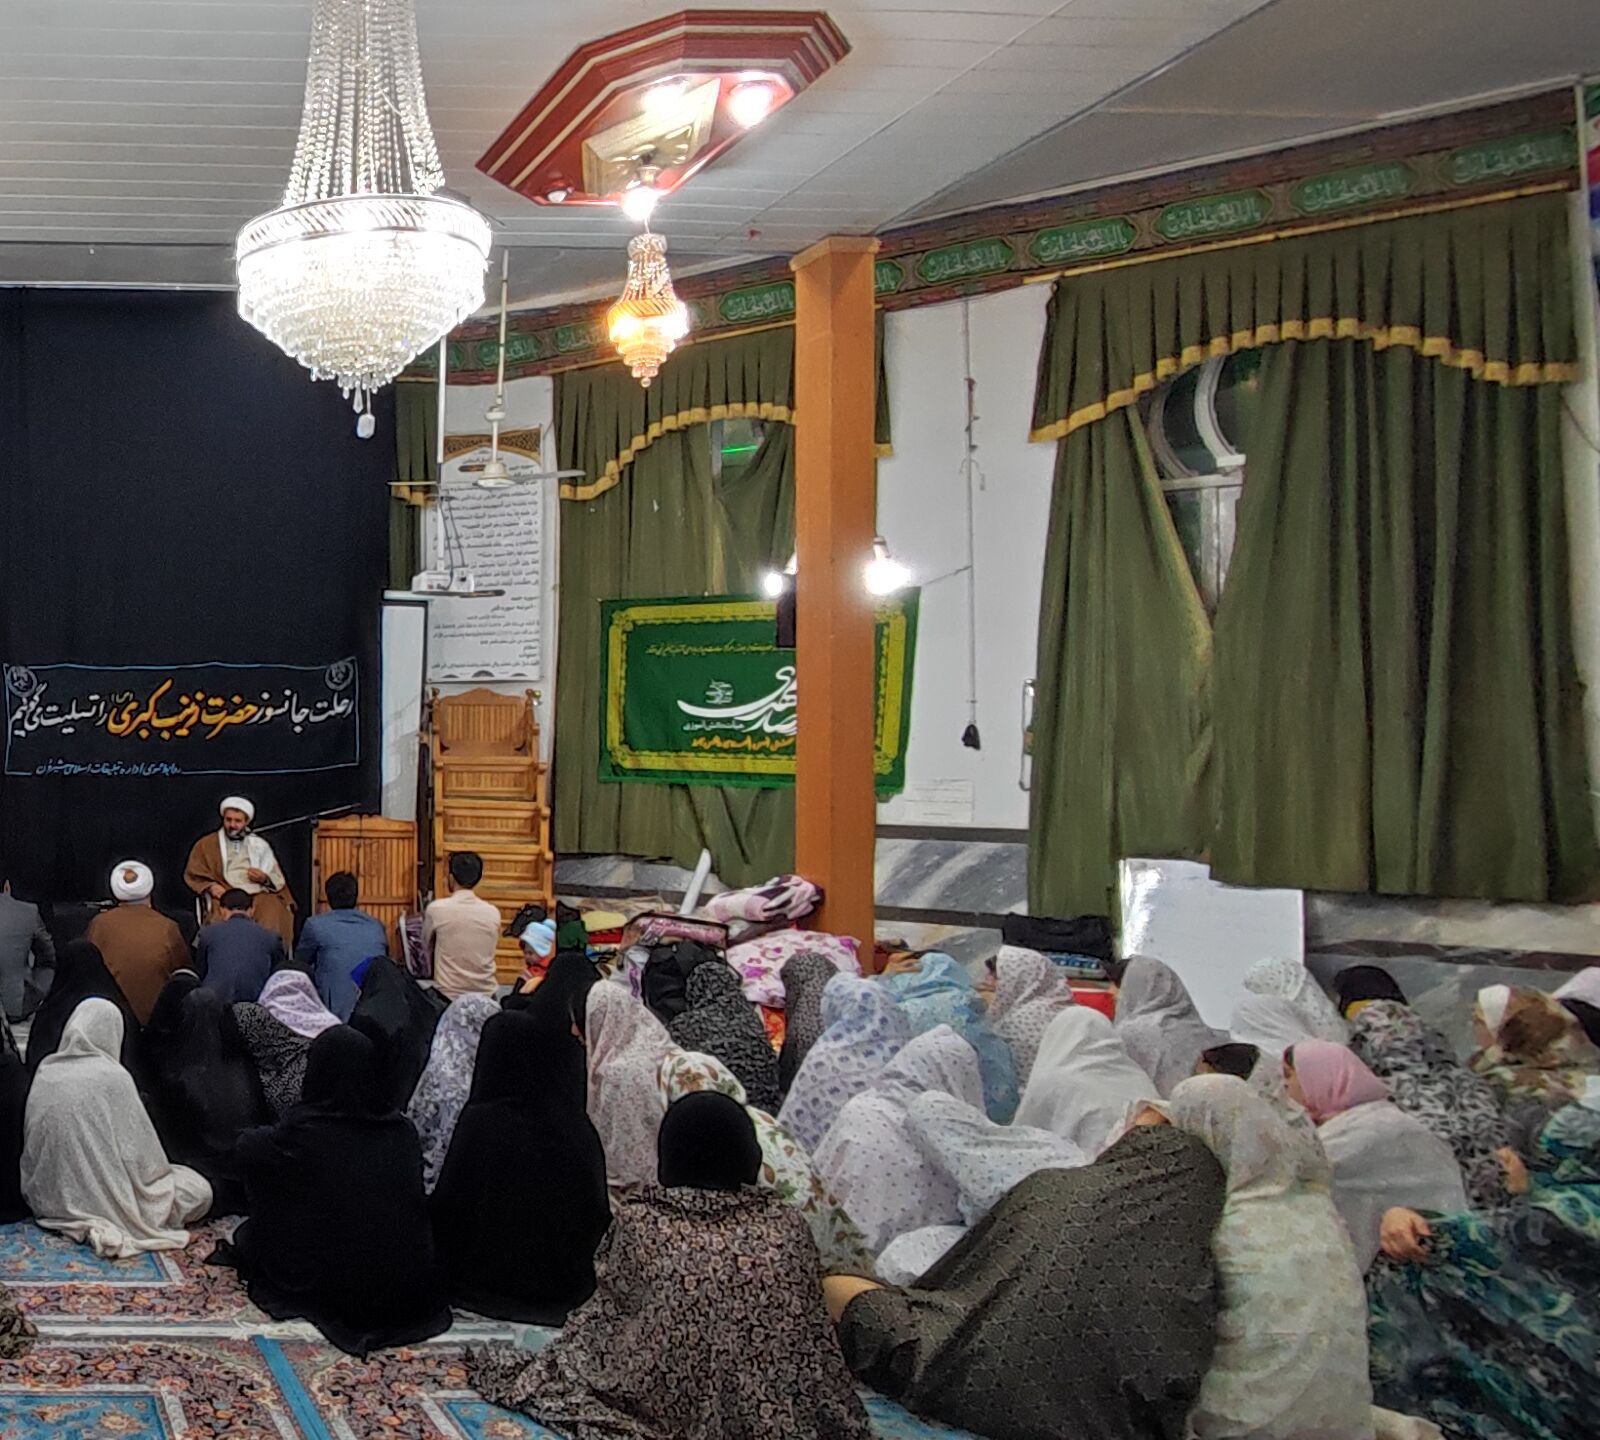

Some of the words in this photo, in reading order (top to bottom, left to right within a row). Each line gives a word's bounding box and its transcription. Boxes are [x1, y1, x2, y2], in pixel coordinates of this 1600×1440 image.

[41, 694, 100, 734] تسلیت
[107, 678, 173, 739] کبری
[151, 690, 204, 740] زینب
[201, 695, 259, 740] حضرت
[245, 689, 310, 733] جانسوز
[308, 692, 354, 723] رحلت
